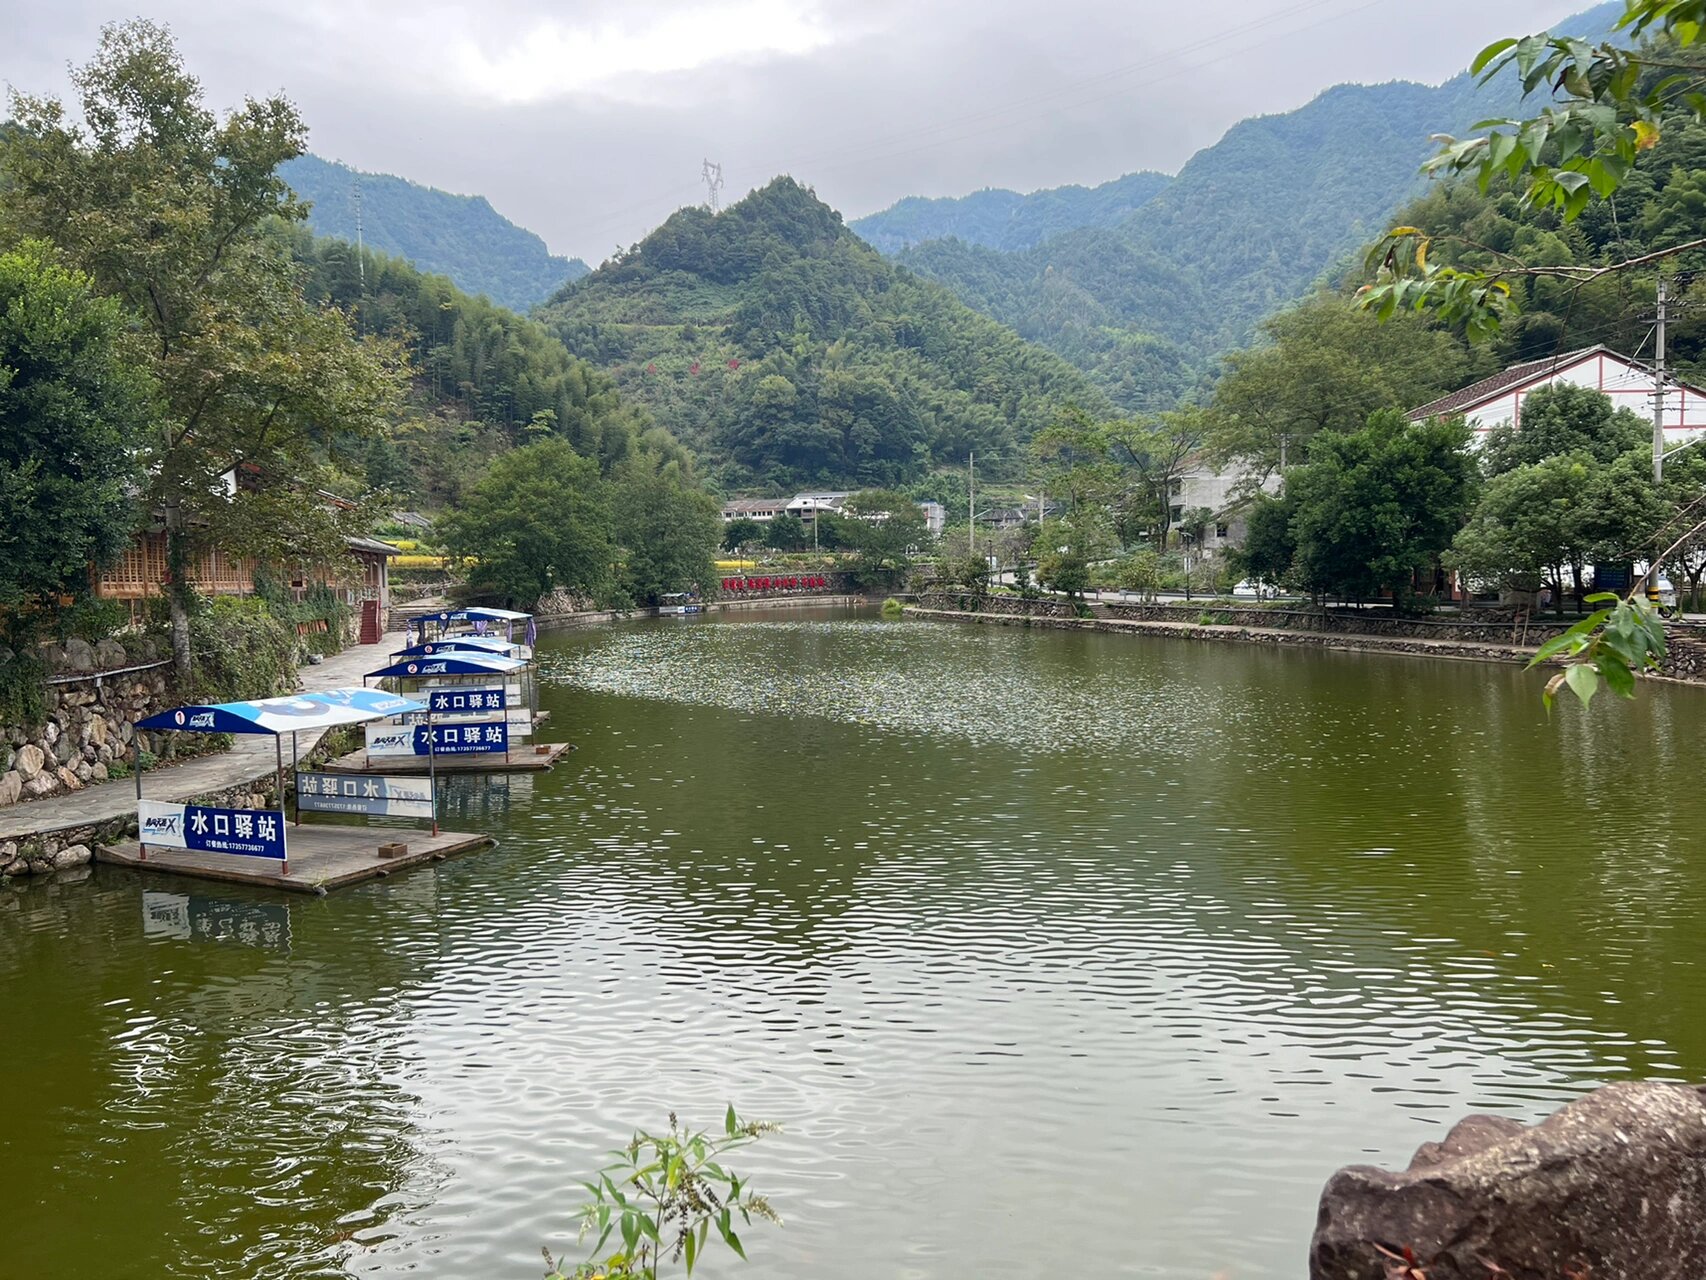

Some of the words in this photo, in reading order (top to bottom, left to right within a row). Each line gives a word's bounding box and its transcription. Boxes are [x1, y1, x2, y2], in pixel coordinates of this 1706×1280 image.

[435, 693, 500, 709] 水口驿站
[421, 726, 503, 745] 水口驿站
[191, 810, 276, 842] 水口驿站
